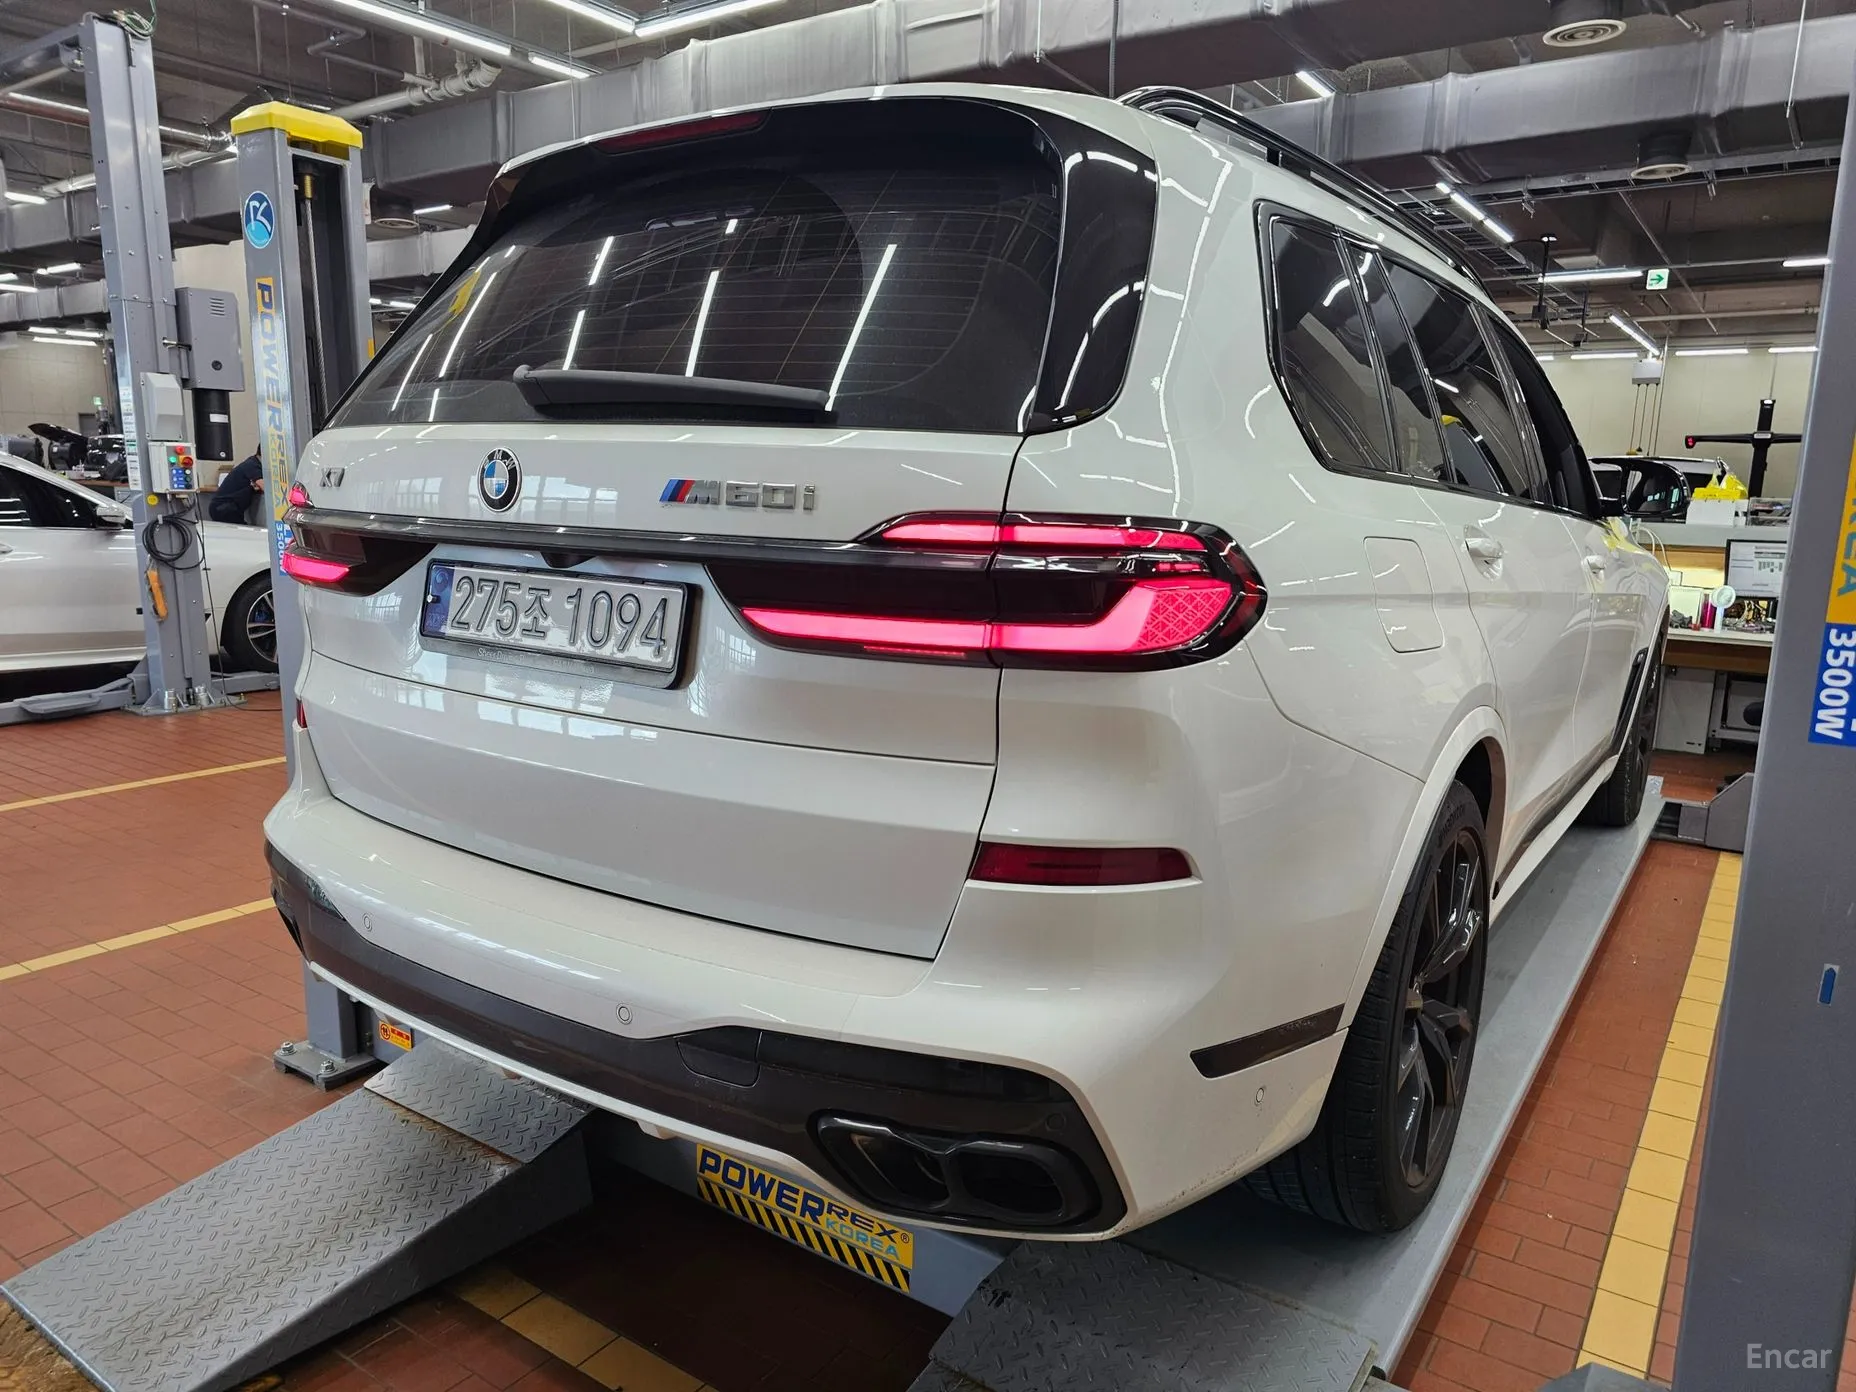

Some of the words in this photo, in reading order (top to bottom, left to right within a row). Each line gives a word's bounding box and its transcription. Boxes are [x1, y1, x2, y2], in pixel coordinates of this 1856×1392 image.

[319, 467, 345, 488] X7
[684, 479, 816, 511] M60i
[451, 575, 551, 638] 275조
[566, 587, 669, 657] 1094
[1815, 628, 1856, 740] 3500W
[825, 1217, 900, 1261] KOREA
